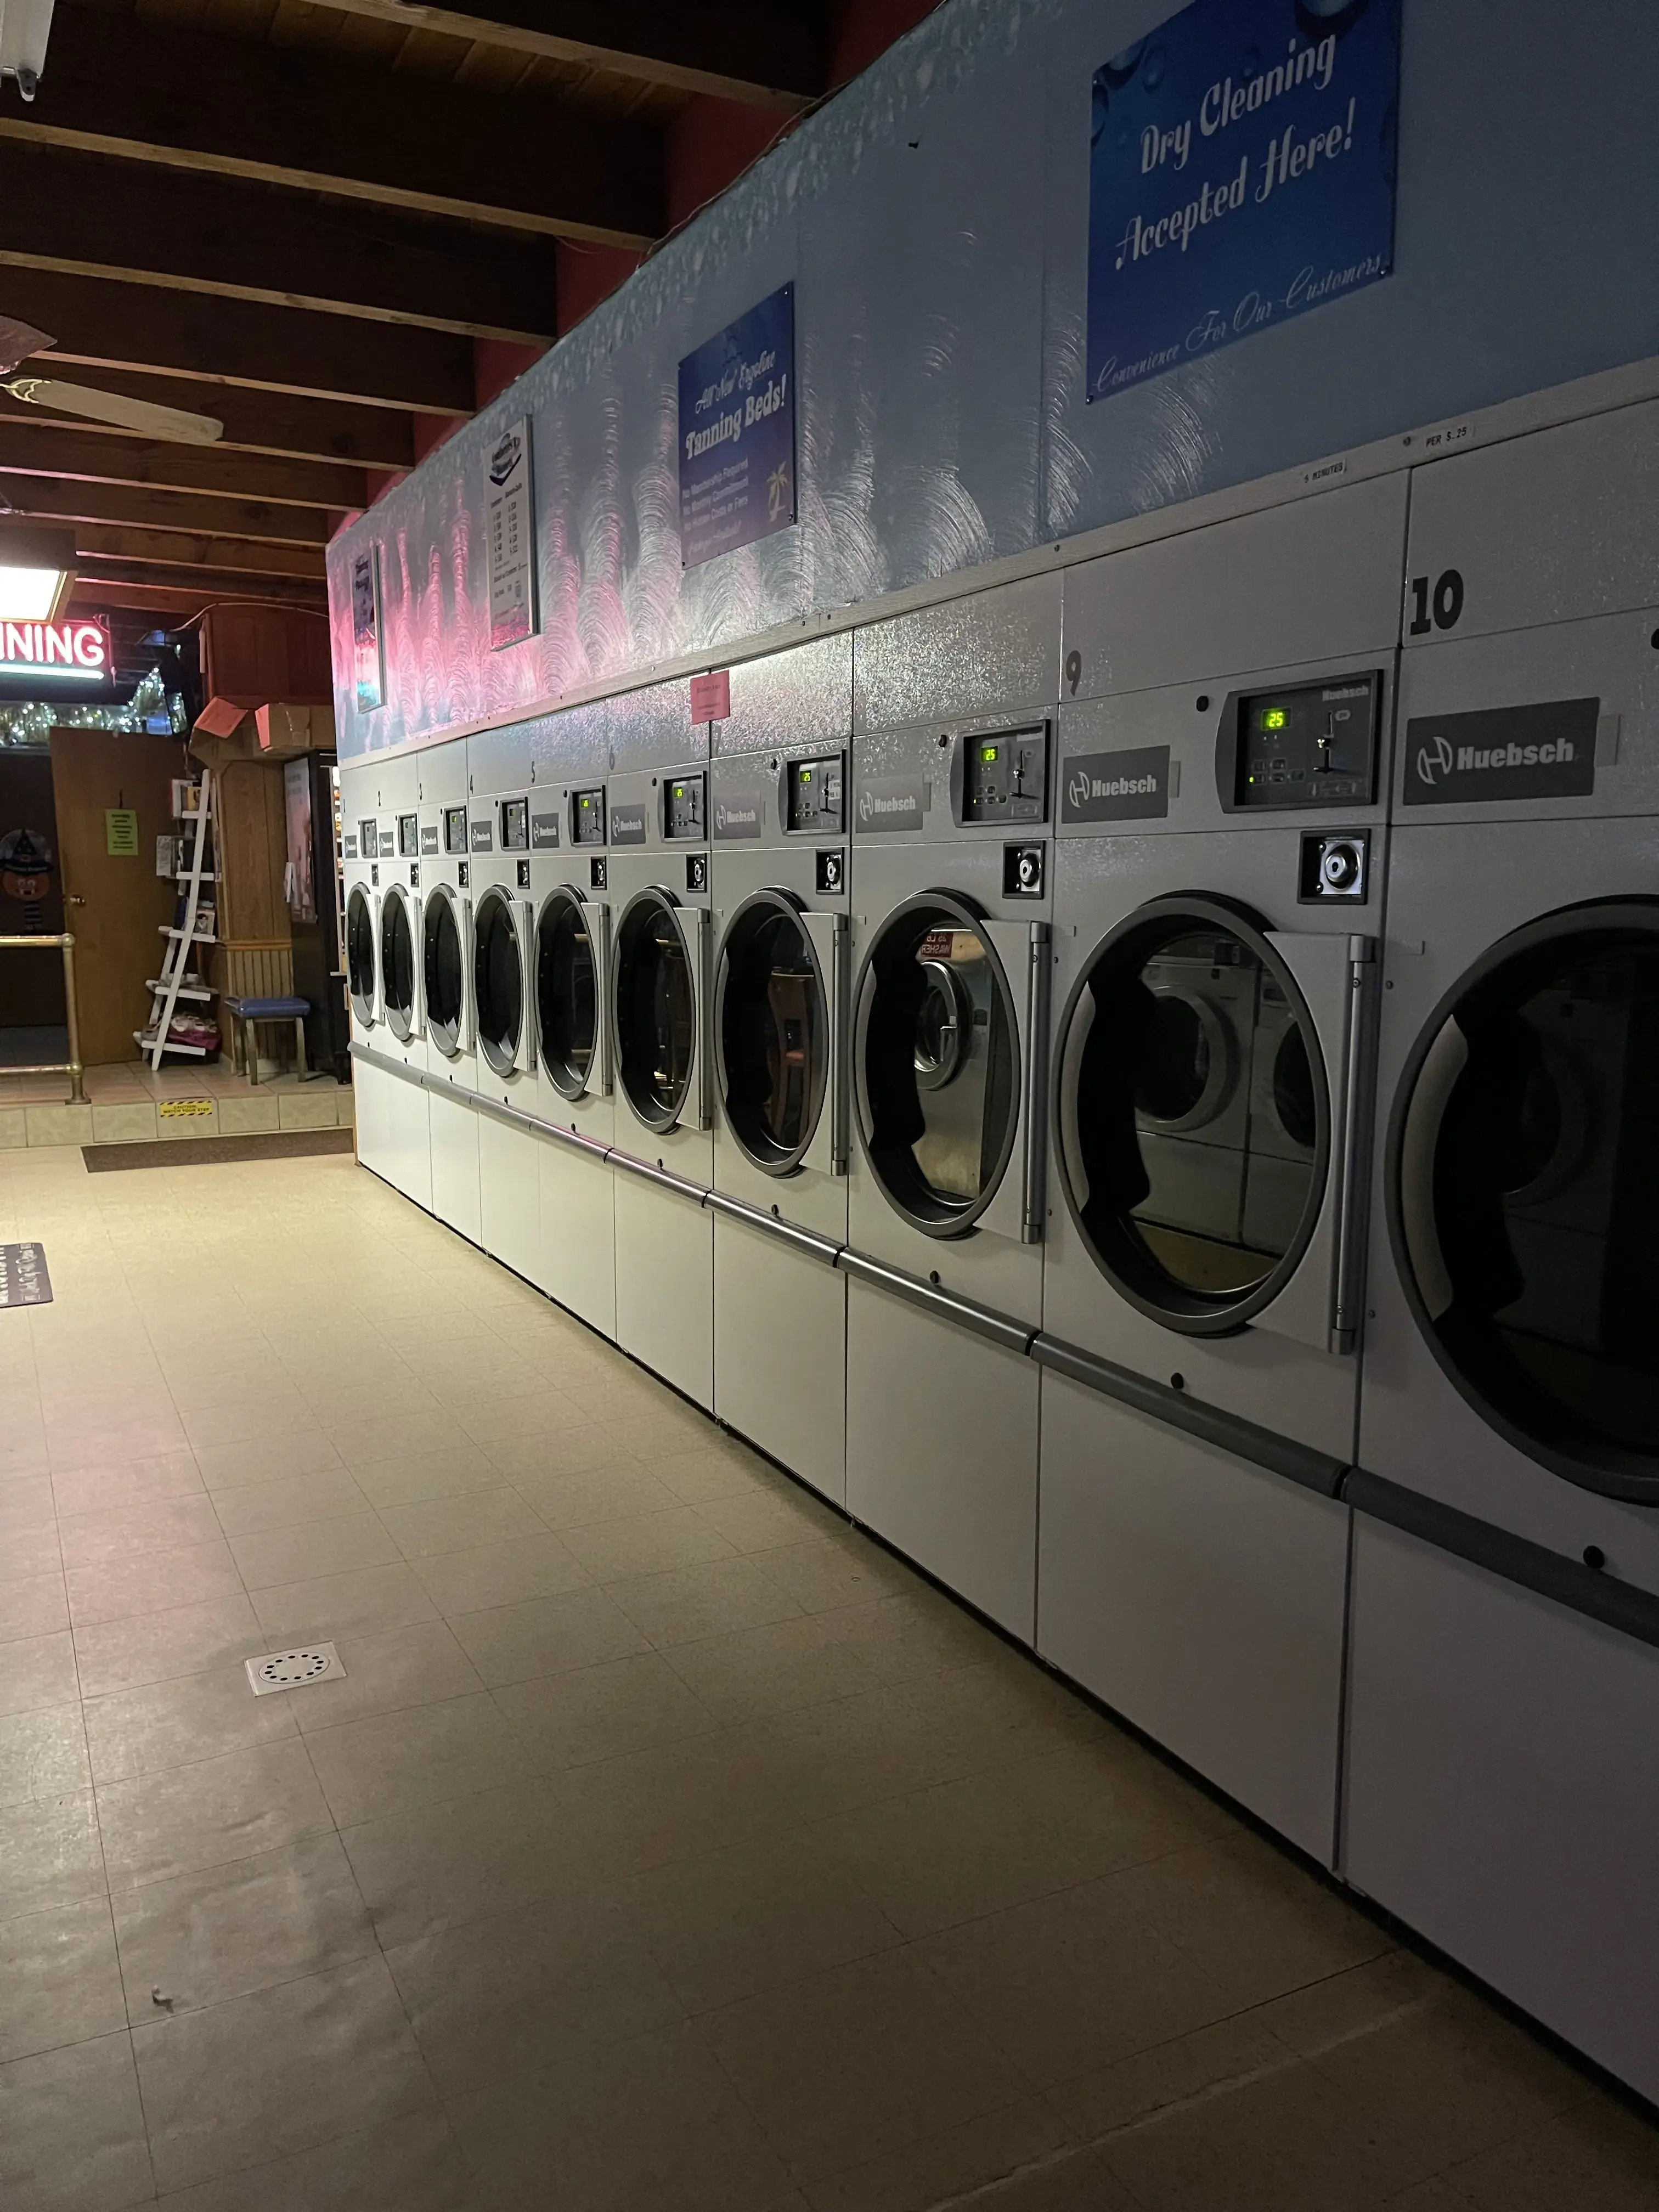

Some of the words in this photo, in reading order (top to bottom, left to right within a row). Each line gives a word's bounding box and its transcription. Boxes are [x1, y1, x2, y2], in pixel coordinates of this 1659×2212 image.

[1139, 119, 1192, 174] Dry
[1200, 33, 1337, 137] Cleaning
[1115, 155, 1248, 270] Accepted
[1254, 96, 1356, 202] Here!
[1093, 343, 1180, 392] Convenience
[1186, 310, 1227, 352] For
[1233, 291, 1272, 333] Our
[685, 408, 742, 460] Tanning
[744, 374, 786, 428] Beds!
[1426, 435, 1442, 448] PER
[1312, 462, 1344, 481] MINUTES
[1410, 569, 1464, 635] 10
[0, 621, 104, 667] NING
[1066, 650, 1082, 696] 9
[1268, 712, 1284, 727] 25
[986, 748, 995, 761] 25
[1457, 737, 1576, 771] Huebsch
[874, 795, 916, 813] Huebsch
[1092, 775, 1156, 798] Huebsch
